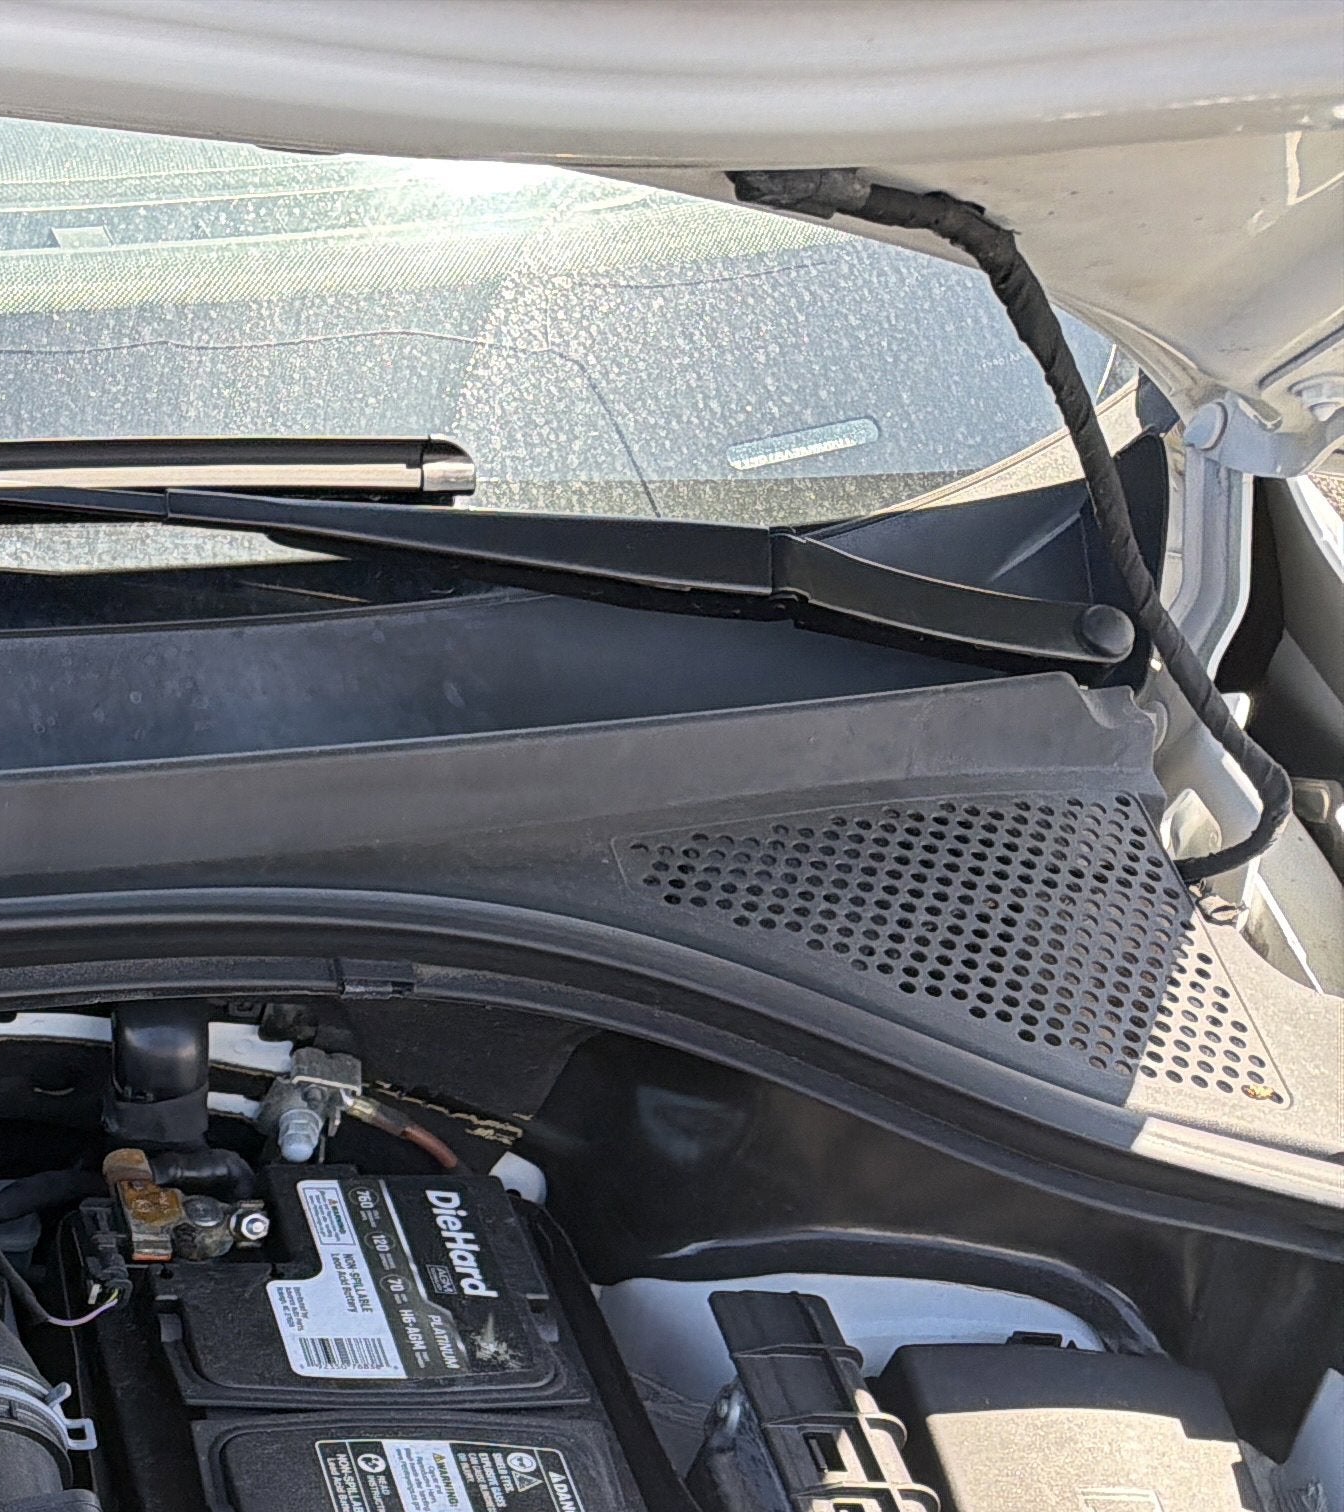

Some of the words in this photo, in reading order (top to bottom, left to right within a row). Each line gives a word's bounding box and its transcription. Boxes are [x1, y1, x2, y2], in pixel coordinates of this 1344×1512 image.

[354, 1190, 374, 1208] 760
[370, 1234, 390, 1250] 120
[424, 1189, 498, 1297] DieHard
[386, 1278, 406, 1291] 70
[435, 1267, 453, 1292] AGM
[397, 1309, 428, 1349] H6-AGM
[427, 1315, 460, 1368] PLATINUM
[376, 1475, 390, 1495] READ
